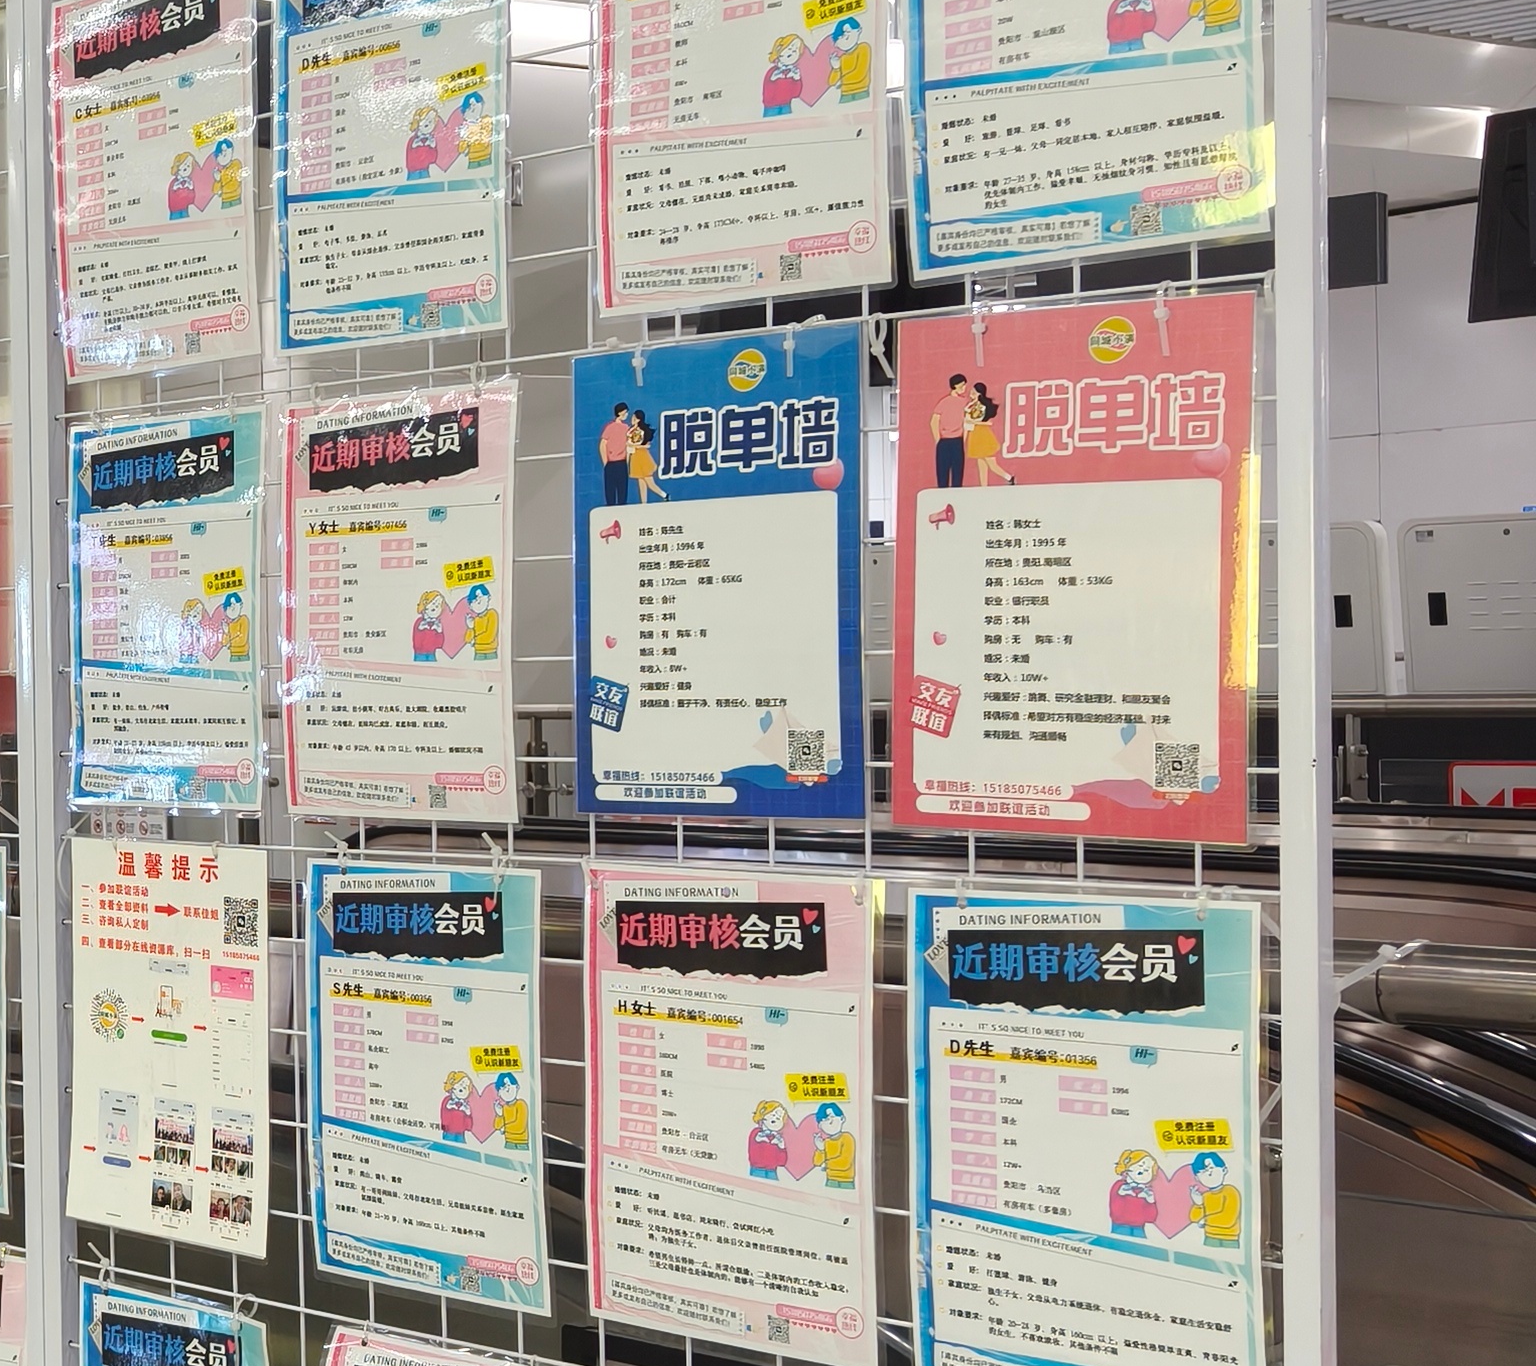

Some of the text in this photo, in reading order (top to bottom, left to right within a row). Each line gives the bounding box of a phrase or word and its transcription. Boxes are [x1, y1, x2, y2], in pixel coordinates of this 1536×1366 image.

[1002, 369, 1225, 458] 脱单墙
[312, 419, 460, 474] 近期审核会员
[658, 392, 839, 480] 脱单墙
[94, 441, 219, 492] 近期审核会员
[595, 681, 627, 703] 交友
[918, 682, 959, 707] 交友
[910, 707, 947, 732] 联谊
[118, 851, 219, 883] 温馨提示
[336, 902, 485, 937] 近期审核会员
[619, 912, 803, 952] 近期审核会员
[959, 912, 1101, 925] DATING INFORMATION
[953, 942, 1178, 985] 近期审核会员
